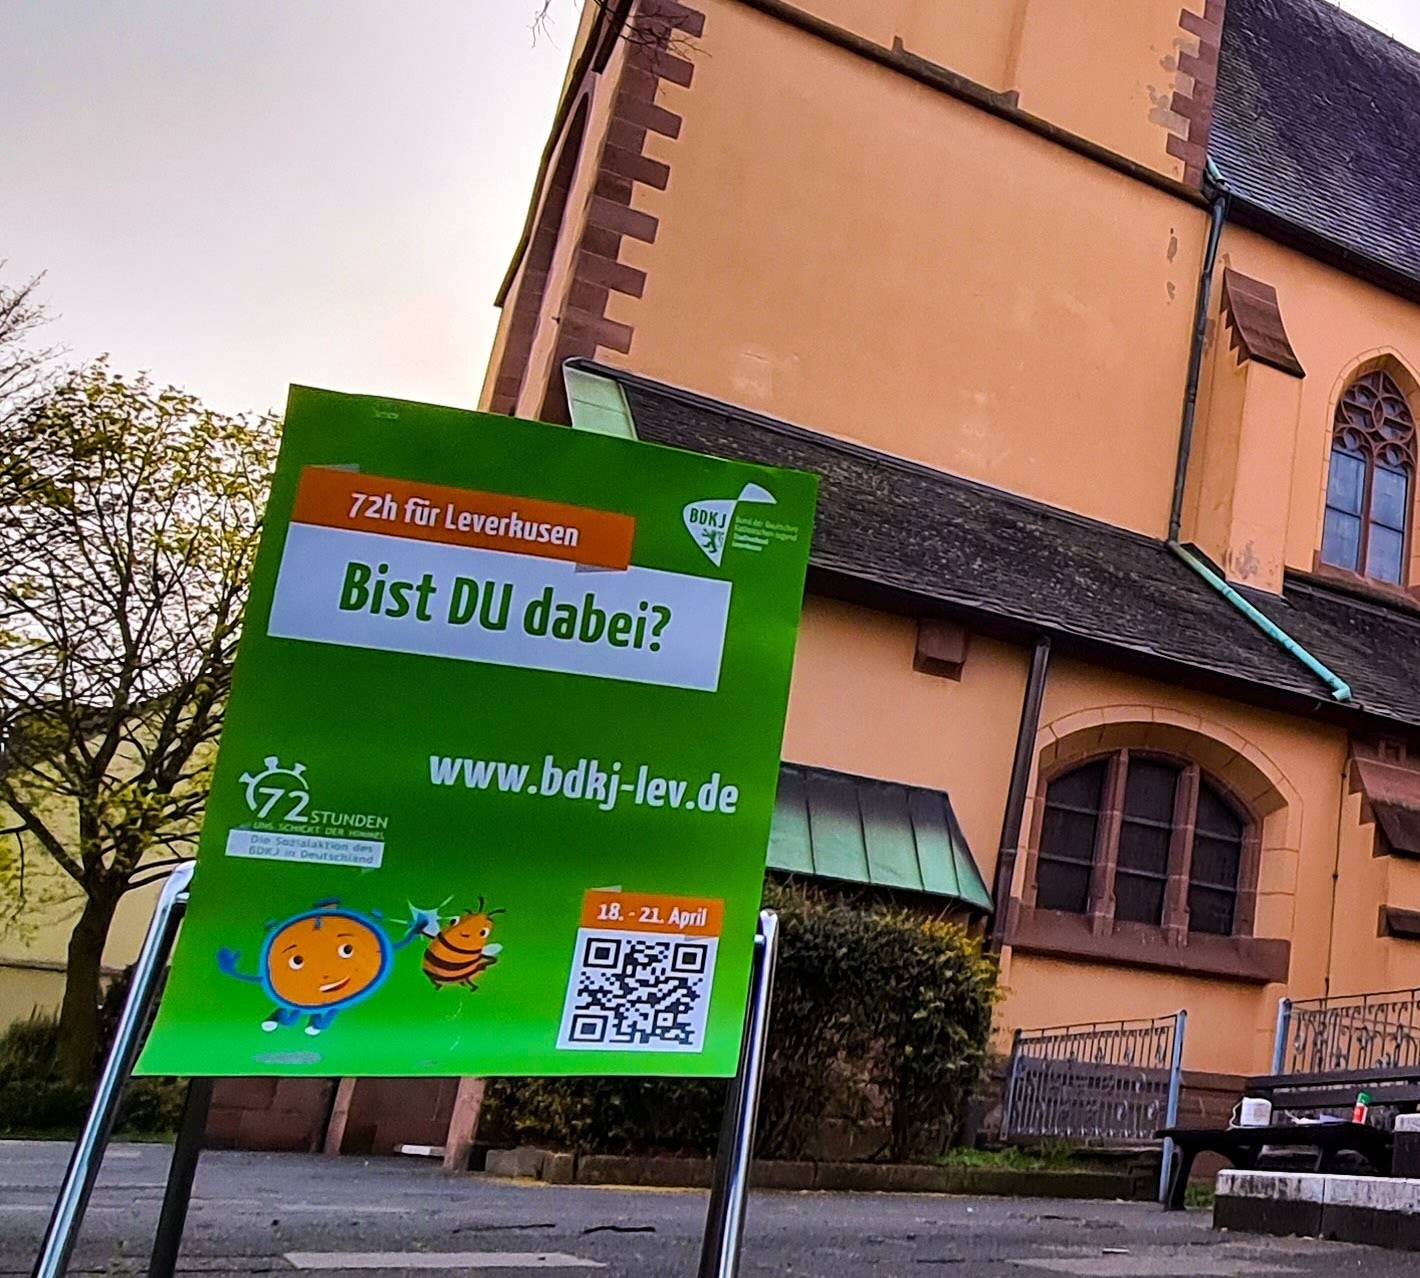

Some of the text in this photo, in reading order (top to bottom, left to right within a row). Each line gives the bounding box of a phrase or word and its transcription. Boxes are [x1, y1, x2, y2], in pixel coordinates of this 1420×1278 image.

[348, 493, 579, 547] 72h für Leverkusen
[689, 507, 727, 529] BDKJ
[339, 561, 672, 652] Bist DU dabei?
[429, 755, 739, 813] www.bdkj-lev.de
[257, 787, 389, 829] 72 STUNDEN
[278, 823, 320, 835] SCHICKT
[325, 828, 345, 836] DER
[251, 835, 271, 844] Die
[276, 836, 349, 851] Sozialaktion
[300, 850, 374, 864] Deutschland
[597, 903, 624, 922] 18.
[639, 906, 664, 924] 21.
[668, 907, 708, 929] April
